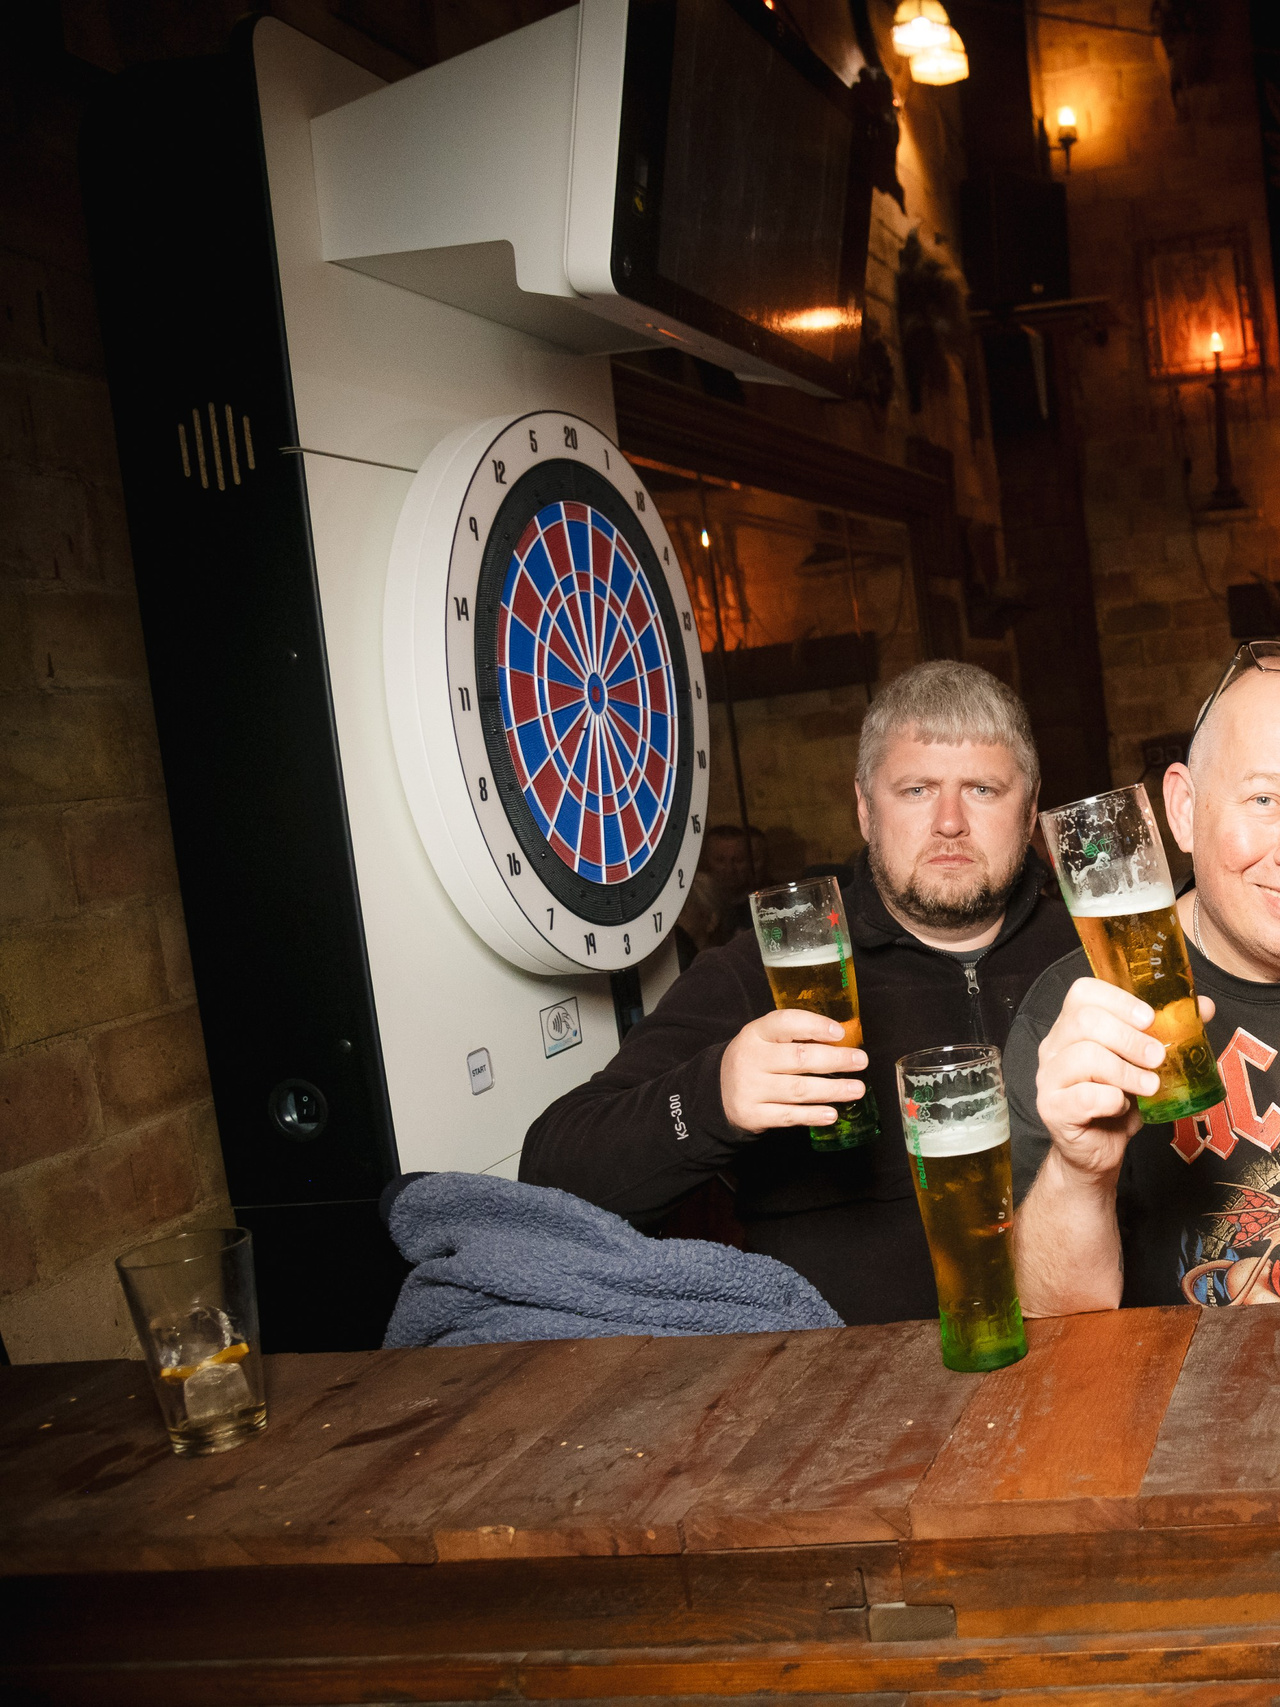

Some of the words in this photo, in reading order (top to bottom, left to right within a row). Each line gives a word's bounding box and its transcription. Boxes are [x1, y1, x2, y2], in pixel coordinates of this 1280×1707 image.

[529, 430, 538, 453] 5
[564, 426, 578, 450] 20
[603, 449, 610, 470] 1
[492, 459, 507, 485] 12
[635, 490, 646, 512] 18
[469, 516, 479, 541] 9
[663, 546, 670, 566] 4
[453, 596, 470, 621] 14
[682, 611, 692, 631] 13
[458, 687, 471, 711] 11
[695, 680, 703, 699] 6
[697, 750, 707, 769] 10
[478, 776, 488, 801] 8
[691, 814, 701, 834] 15
[508, 852, 522, 876] 16
[678, 868, 685, 889] 2
[546, 907, 554, 930] 7
[653, 912, 663, 933] 17
[584, 933, 597, 956] 19
[623, 933, 631, 955] 3
[1150, 931, 1168, 980] PURE
[471, 1064, 487, 1077] START
[669, 1094, 689, 1141] KS-300
